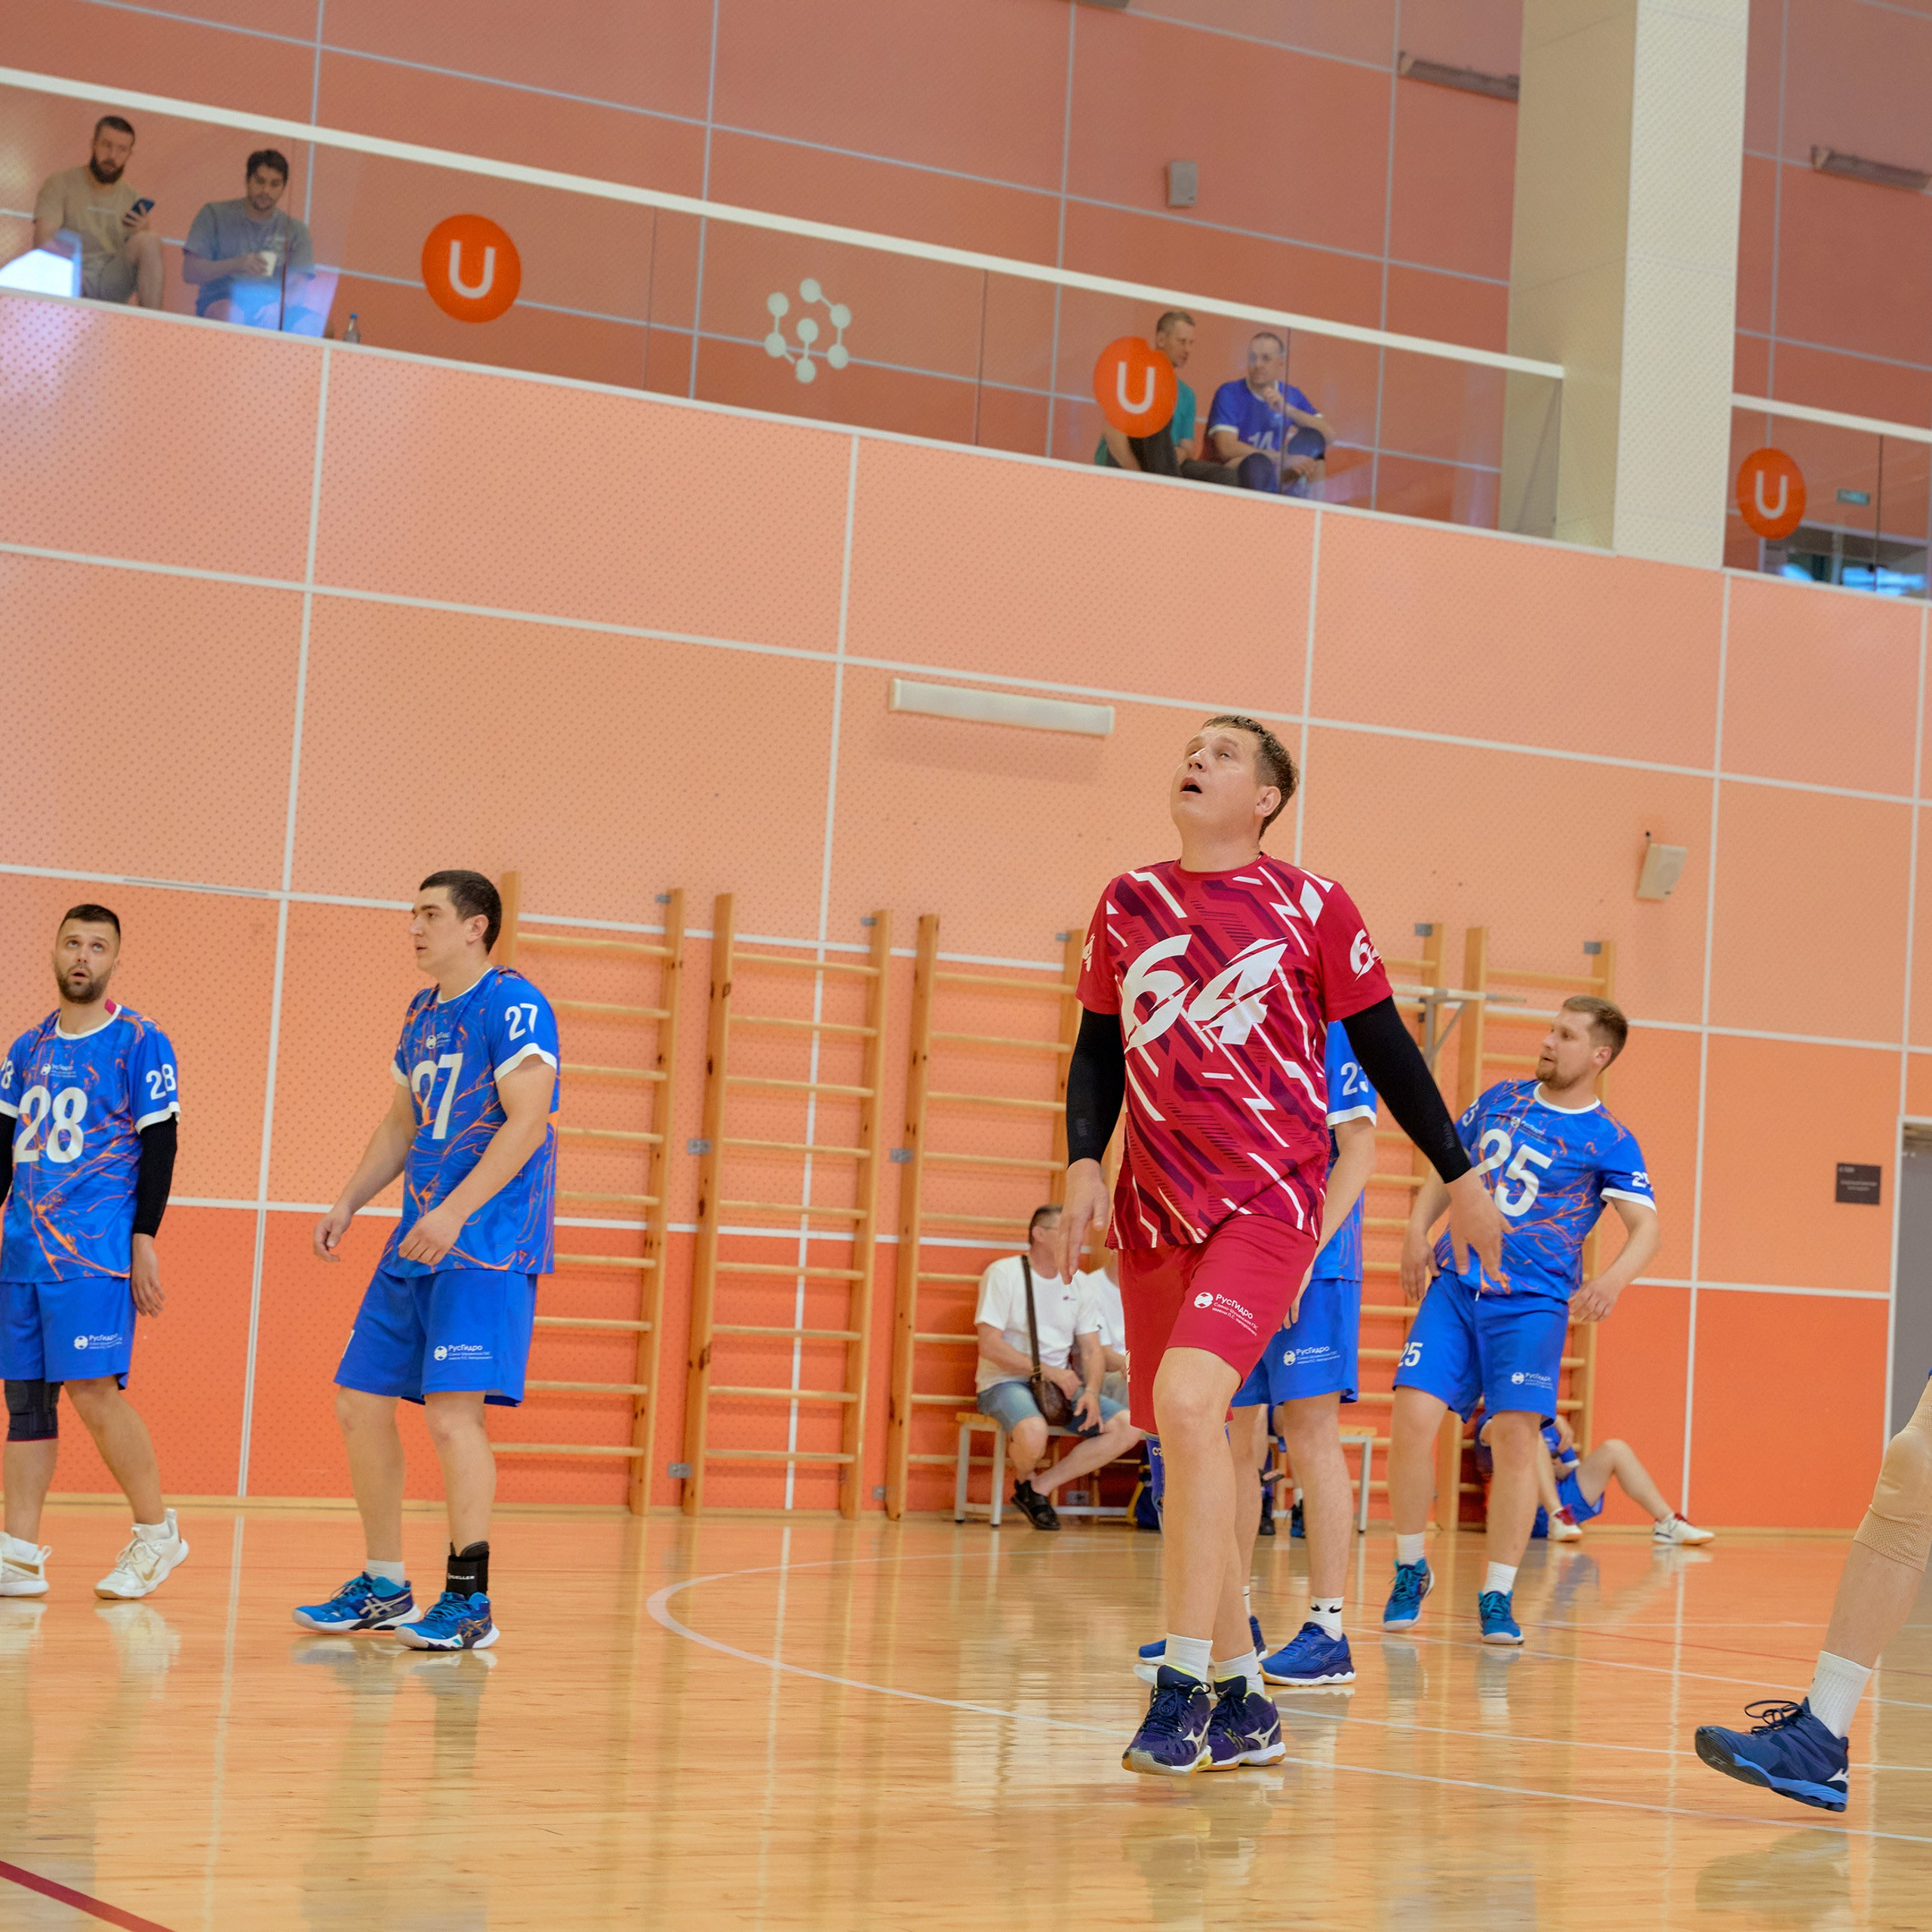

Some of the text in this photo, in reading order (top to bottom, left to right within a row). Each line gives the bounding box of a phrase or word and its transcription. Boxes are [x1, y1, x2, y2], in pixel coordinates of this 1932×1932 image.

[449, 239, 496, 299] U
[1116, 361, 1156, 414] U
[1755, 469, 1789, 520] U
[1120, 934, 1289, 1054] 64
[504, 1002, 539, 1041] 27
[0, 1057, 14, 1089] 8
[145, 1063, 177, 1100] 28
[411, 1052, 464, 1140] 27
[12, 1084, 88, 1164] 28
[1474, 1128, 1553, 1217] 25
[1215, 1294, 1254, 1320] РусГидро
